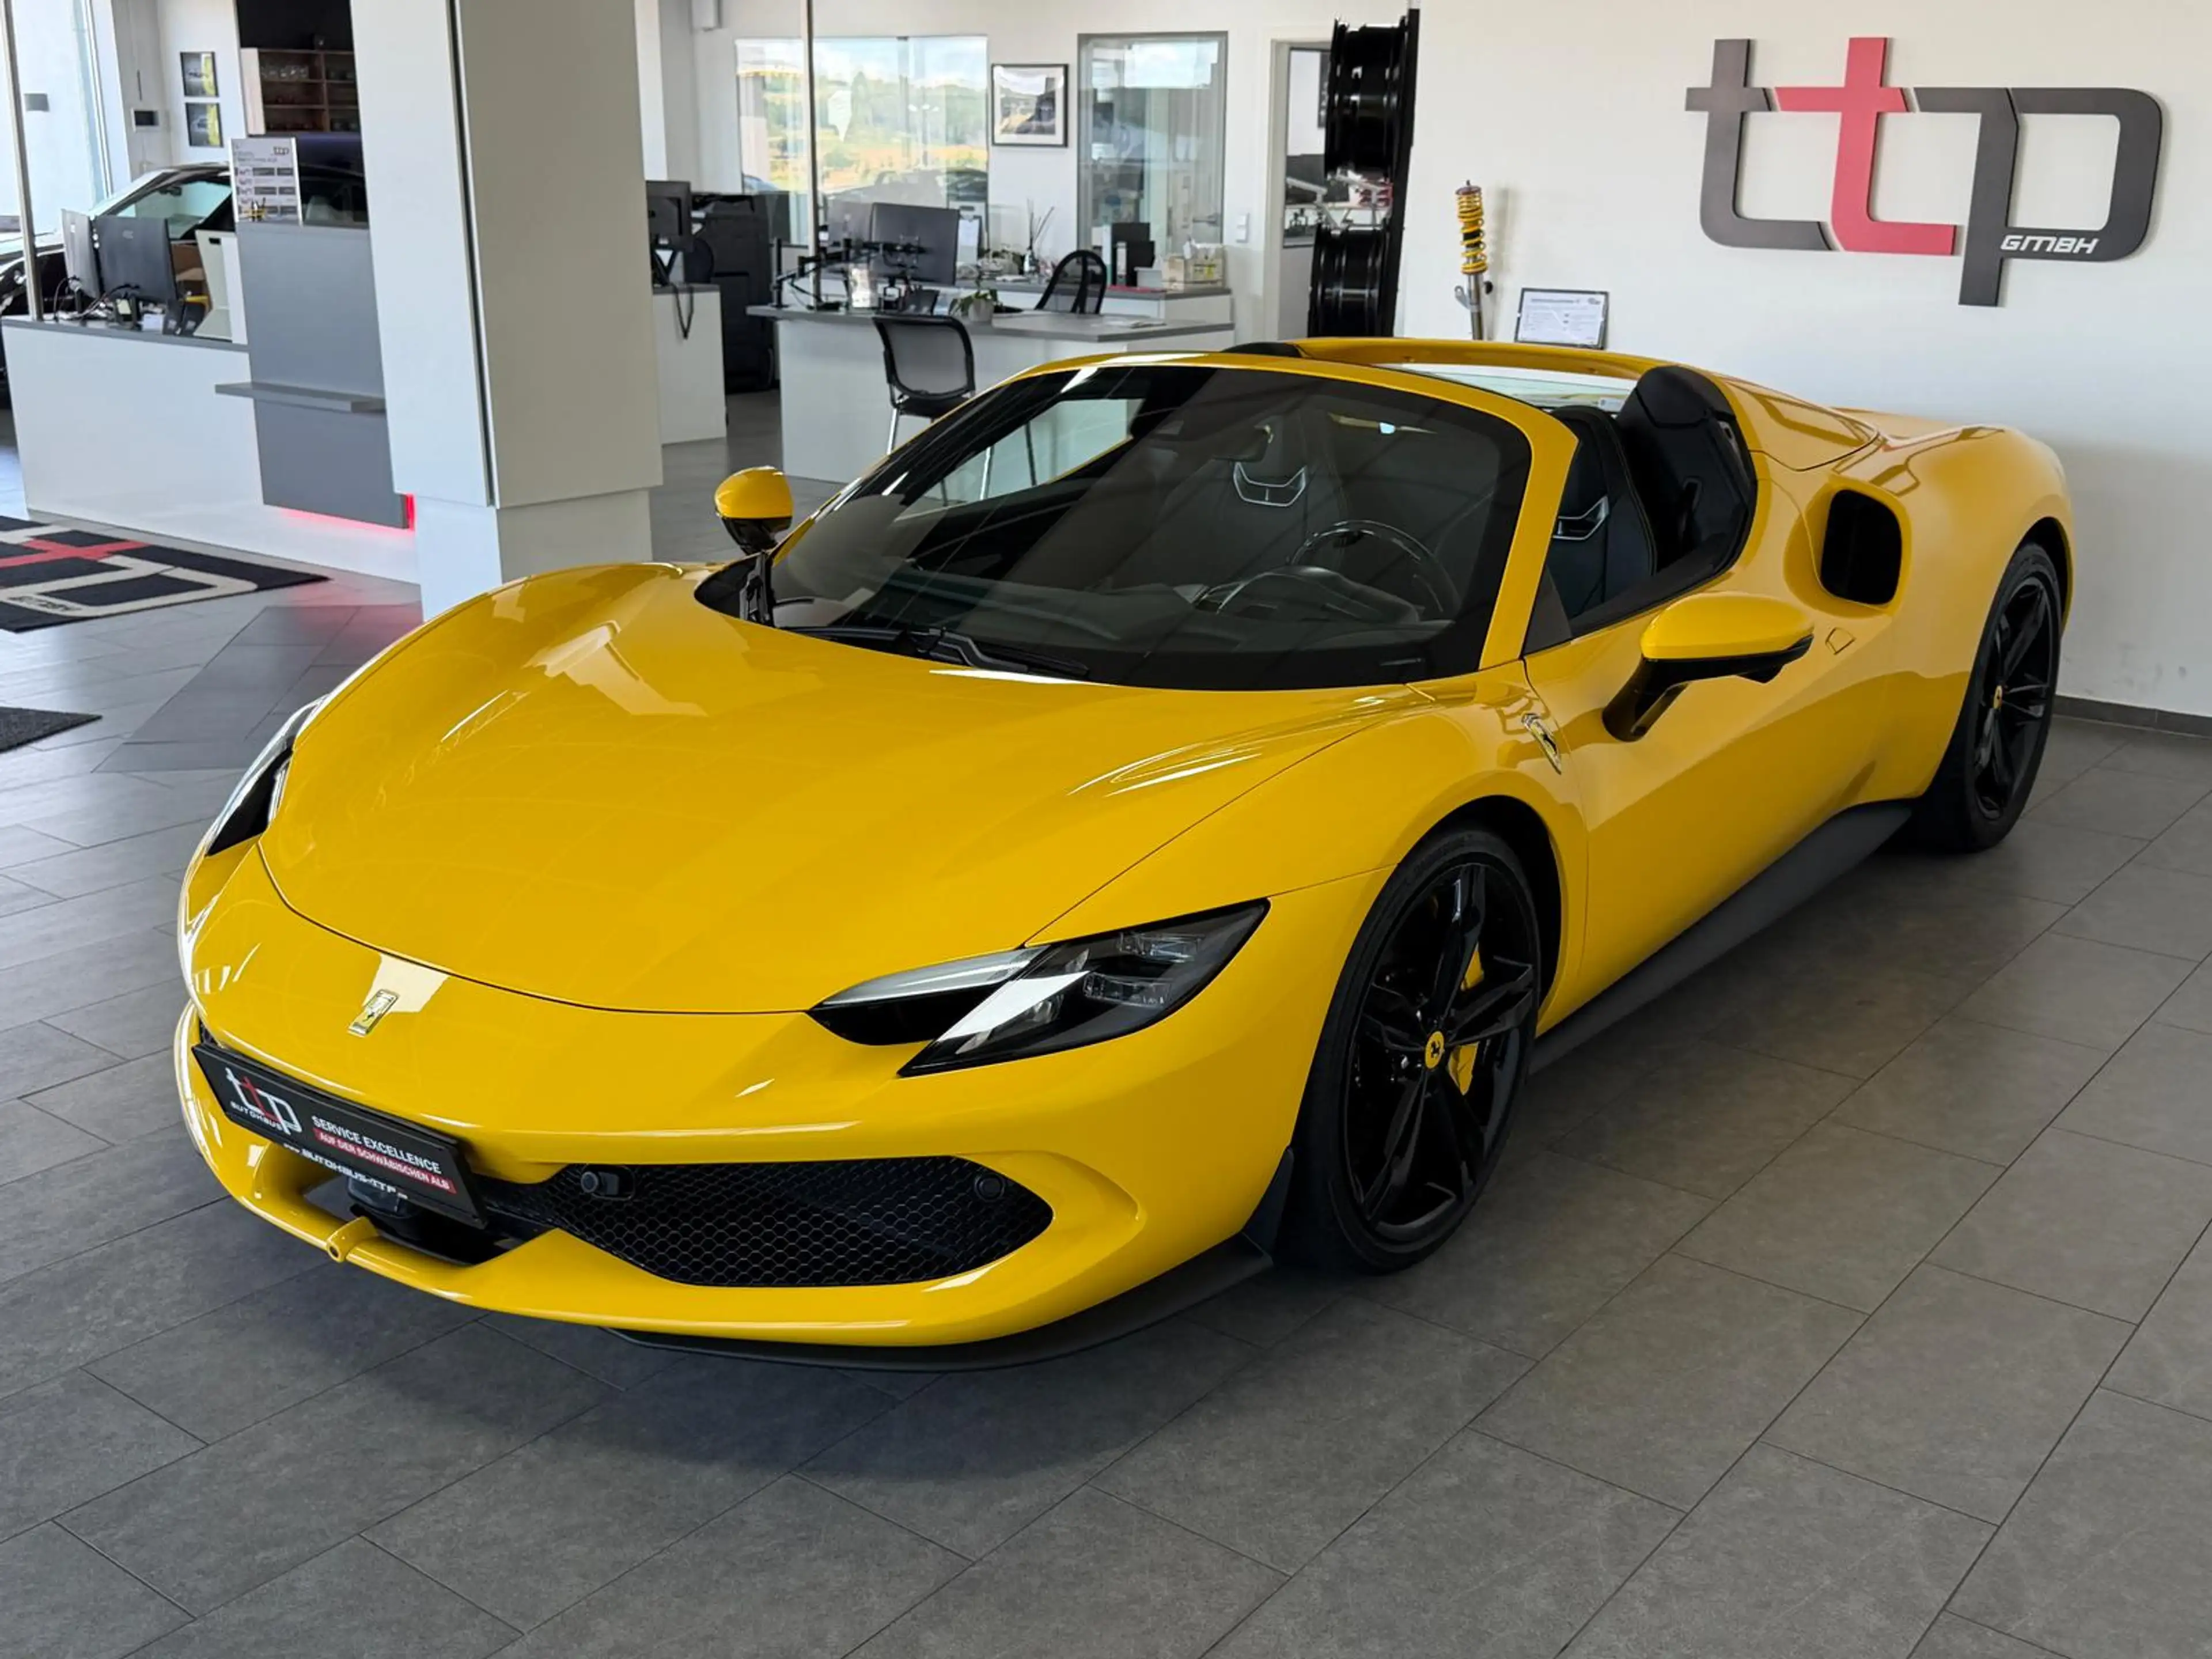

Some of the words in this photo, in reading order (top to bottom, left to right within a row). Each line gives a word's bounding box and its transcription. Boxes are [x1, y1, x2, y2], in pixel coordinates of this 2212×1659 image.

[1685, 37, 2162, 306] ttp
[1999, 234, 2100, 254] GMBH
[312, 1115, 362, 1145] SERVICE
[362, 1136, 441, 1175] EXCELLENCE
